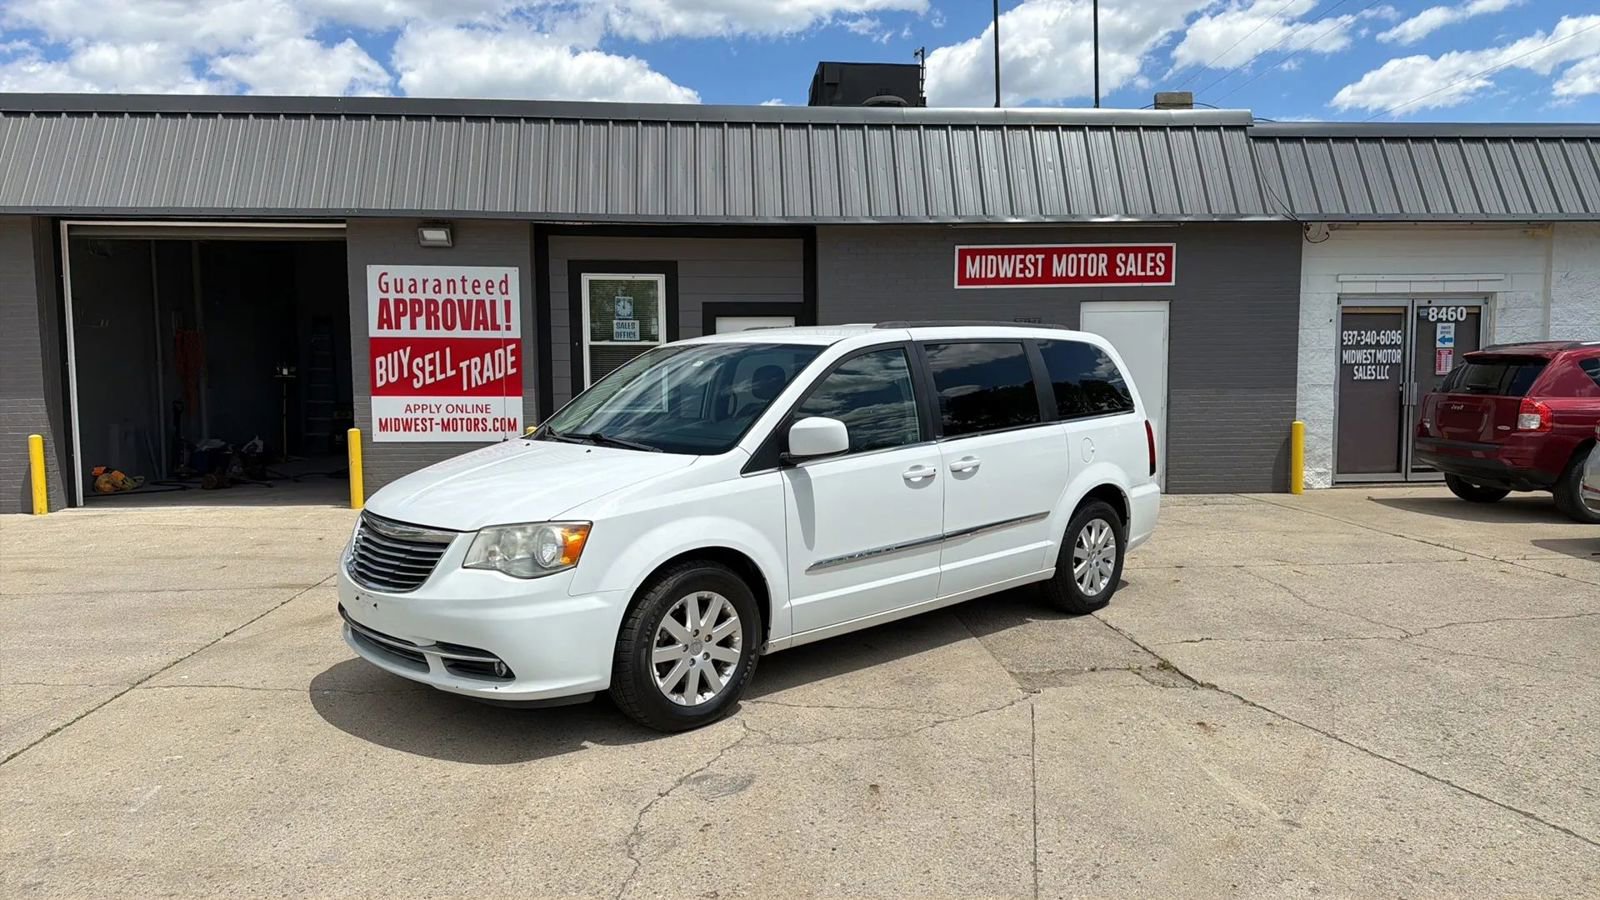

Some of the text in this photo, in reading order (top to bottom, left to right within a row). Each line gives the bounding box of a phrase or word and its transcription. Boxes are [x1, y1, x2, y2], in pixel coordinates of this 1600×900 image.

[966, 252, 1166, 278] MIDWEST MOTOR SALES
[378, 272, 509, 295] Guaranteed
[377, 298, 512, 331] APPROVAL!
[1428, 306, 1467, 321] 8460
[615, 321, 636, 329] SALES
[615, 331, 636, 339] OFFICE
[1342, 330, 1402, 345] 937-340-6096
[1342, 349, 1401, 364] MIDWEST MOTOR
[375, 343, 517, 391] BUY SELL TRADE
[1353, 365, 1389, 379] SALES LLC
[404, 404, 491, 414] APPLY ONLINE
[378, 417, 517, 432] MIDWEST-MOTORS.COM
